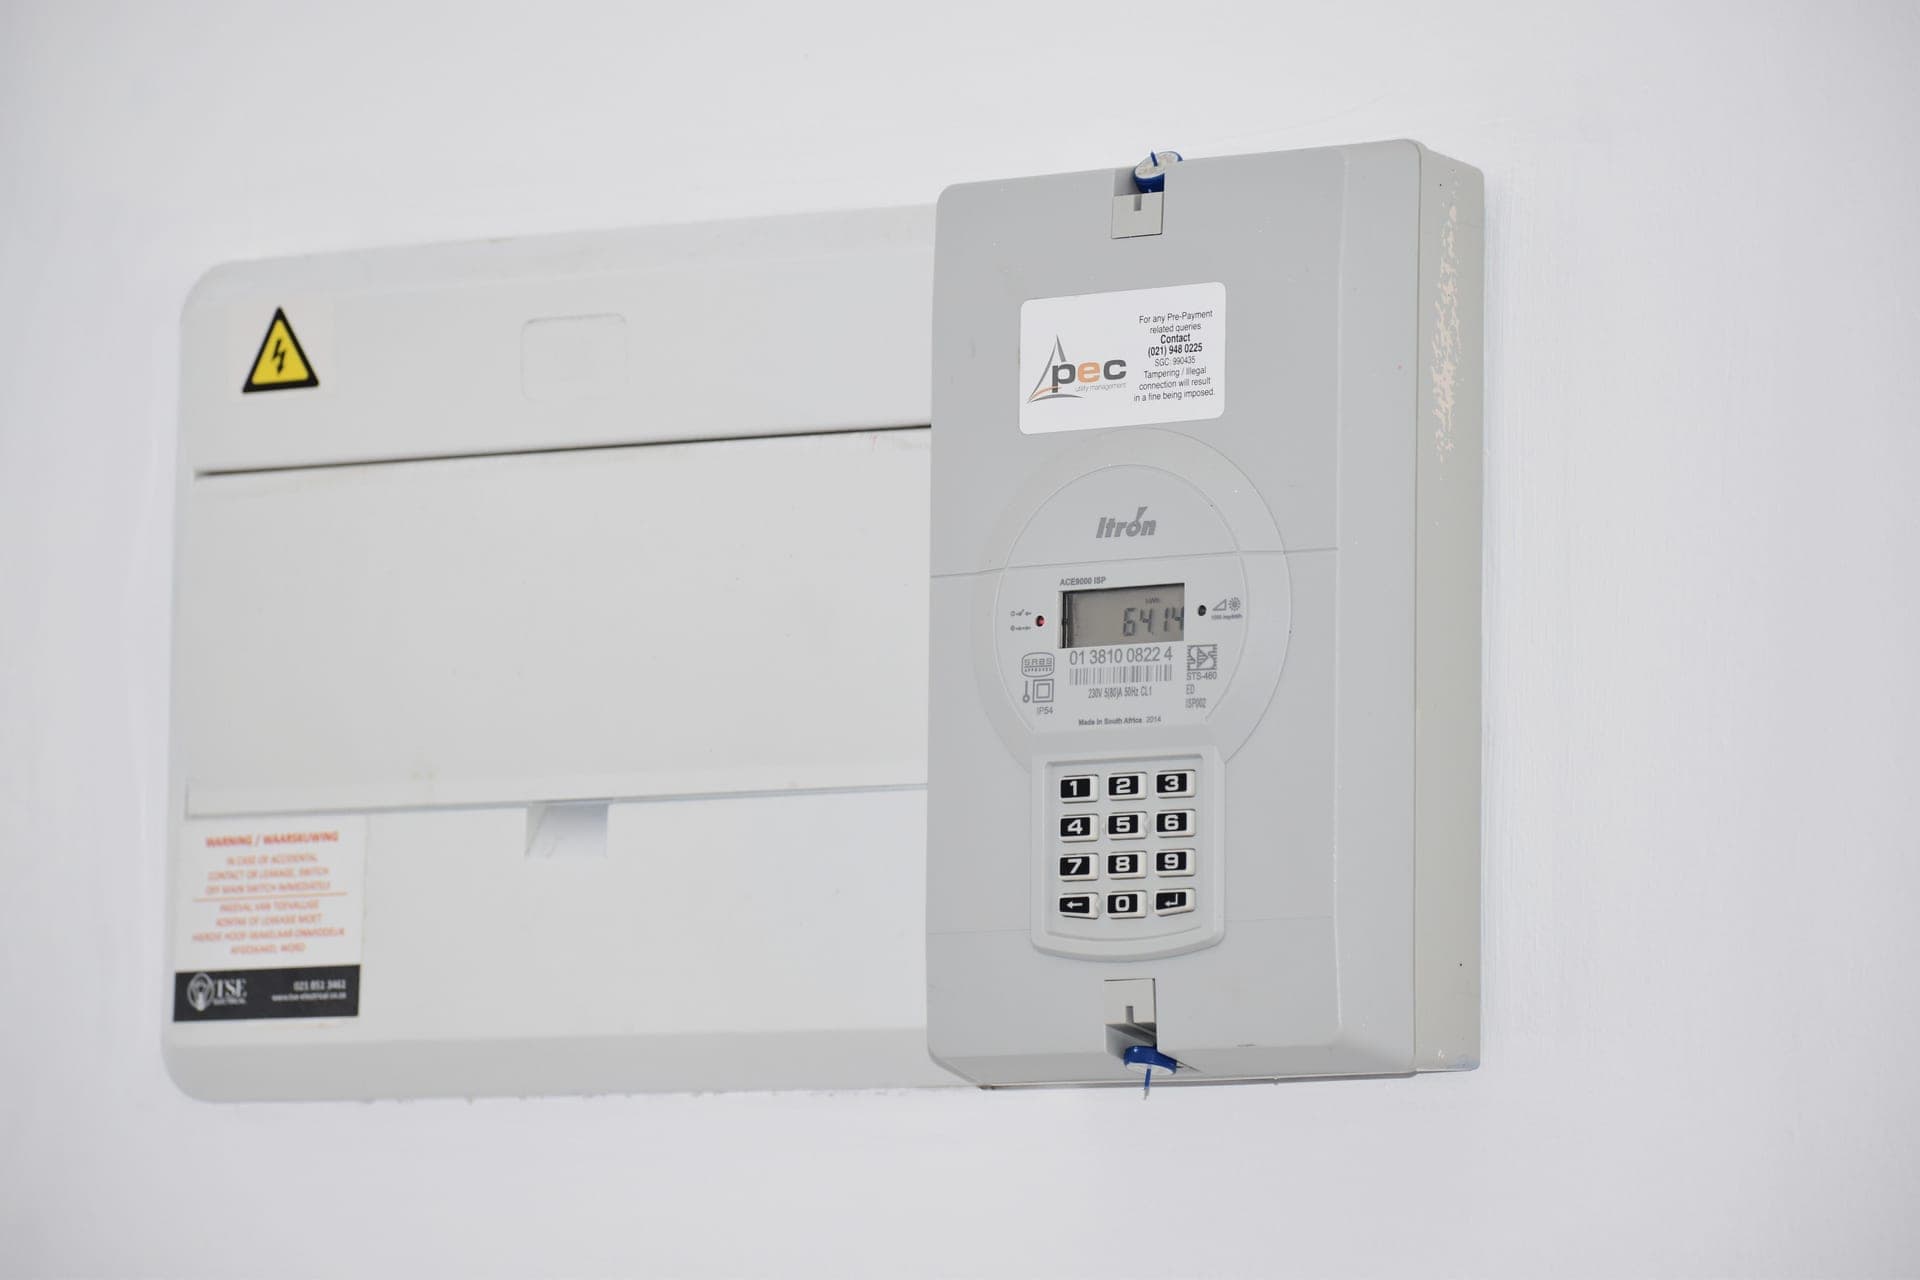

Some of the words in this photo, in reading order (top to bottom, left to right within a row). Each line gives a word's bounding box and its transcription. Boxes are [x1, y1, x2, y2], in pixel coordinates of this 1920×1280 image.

[1139, 315, 1150, 324] For
[1153, 315, 1165, 324] any
[1167, 310, 1213, 321] Pre-Payment
[1150, 324, 1174, 334] related
[1175, 322, 1202, 333] queries
[1160, 333, 1190, 344] Contact
[1148, 346, 1167, 358] (021)
[1169, 344, 1182, 354] 948
[1184, 342, 1202, 353] 0225
[1144, 368, 1180, 379] Tampering
[1186, 366, 1206, 376] Illegal
[1139, 380, 1176, 390] connection
[1178, 378, 1190, 387] will
[1192, 377, 1211, 386] result
[1133, 394, 1140, 402] in
[1142, 394, 1146, 402] a
[1148, 392, 1161, 400] fine
[1162, 390, 1182, 400] being
[1070, 650, 1085, 665] 01
[1089, 648, 1123, 664] 3810
[1126, 646, 1160, 663] 0822
[1164, 646, 1173, 661] 4
[1078, 718, 1095, 726] Made
[1104, 717, 1124, 725] South
[1124, 716, 1142, 724] Africa
[1069, 780, 1078, 796] 1
[1116, 778, 1131, 794] 2
[1164, 775, 1179, 791] 3
[1068, 819, 1082, 834] 4
[1116, 816, 1130, 832] 5
[1164, 814, 1179, 830] 6
[1068, 858, 1082, 874] 7
[1116, 856, 1130, 872] 8
[1164, 854, 1178, 869] 9
[1115, 895, 1130, 912] 0
